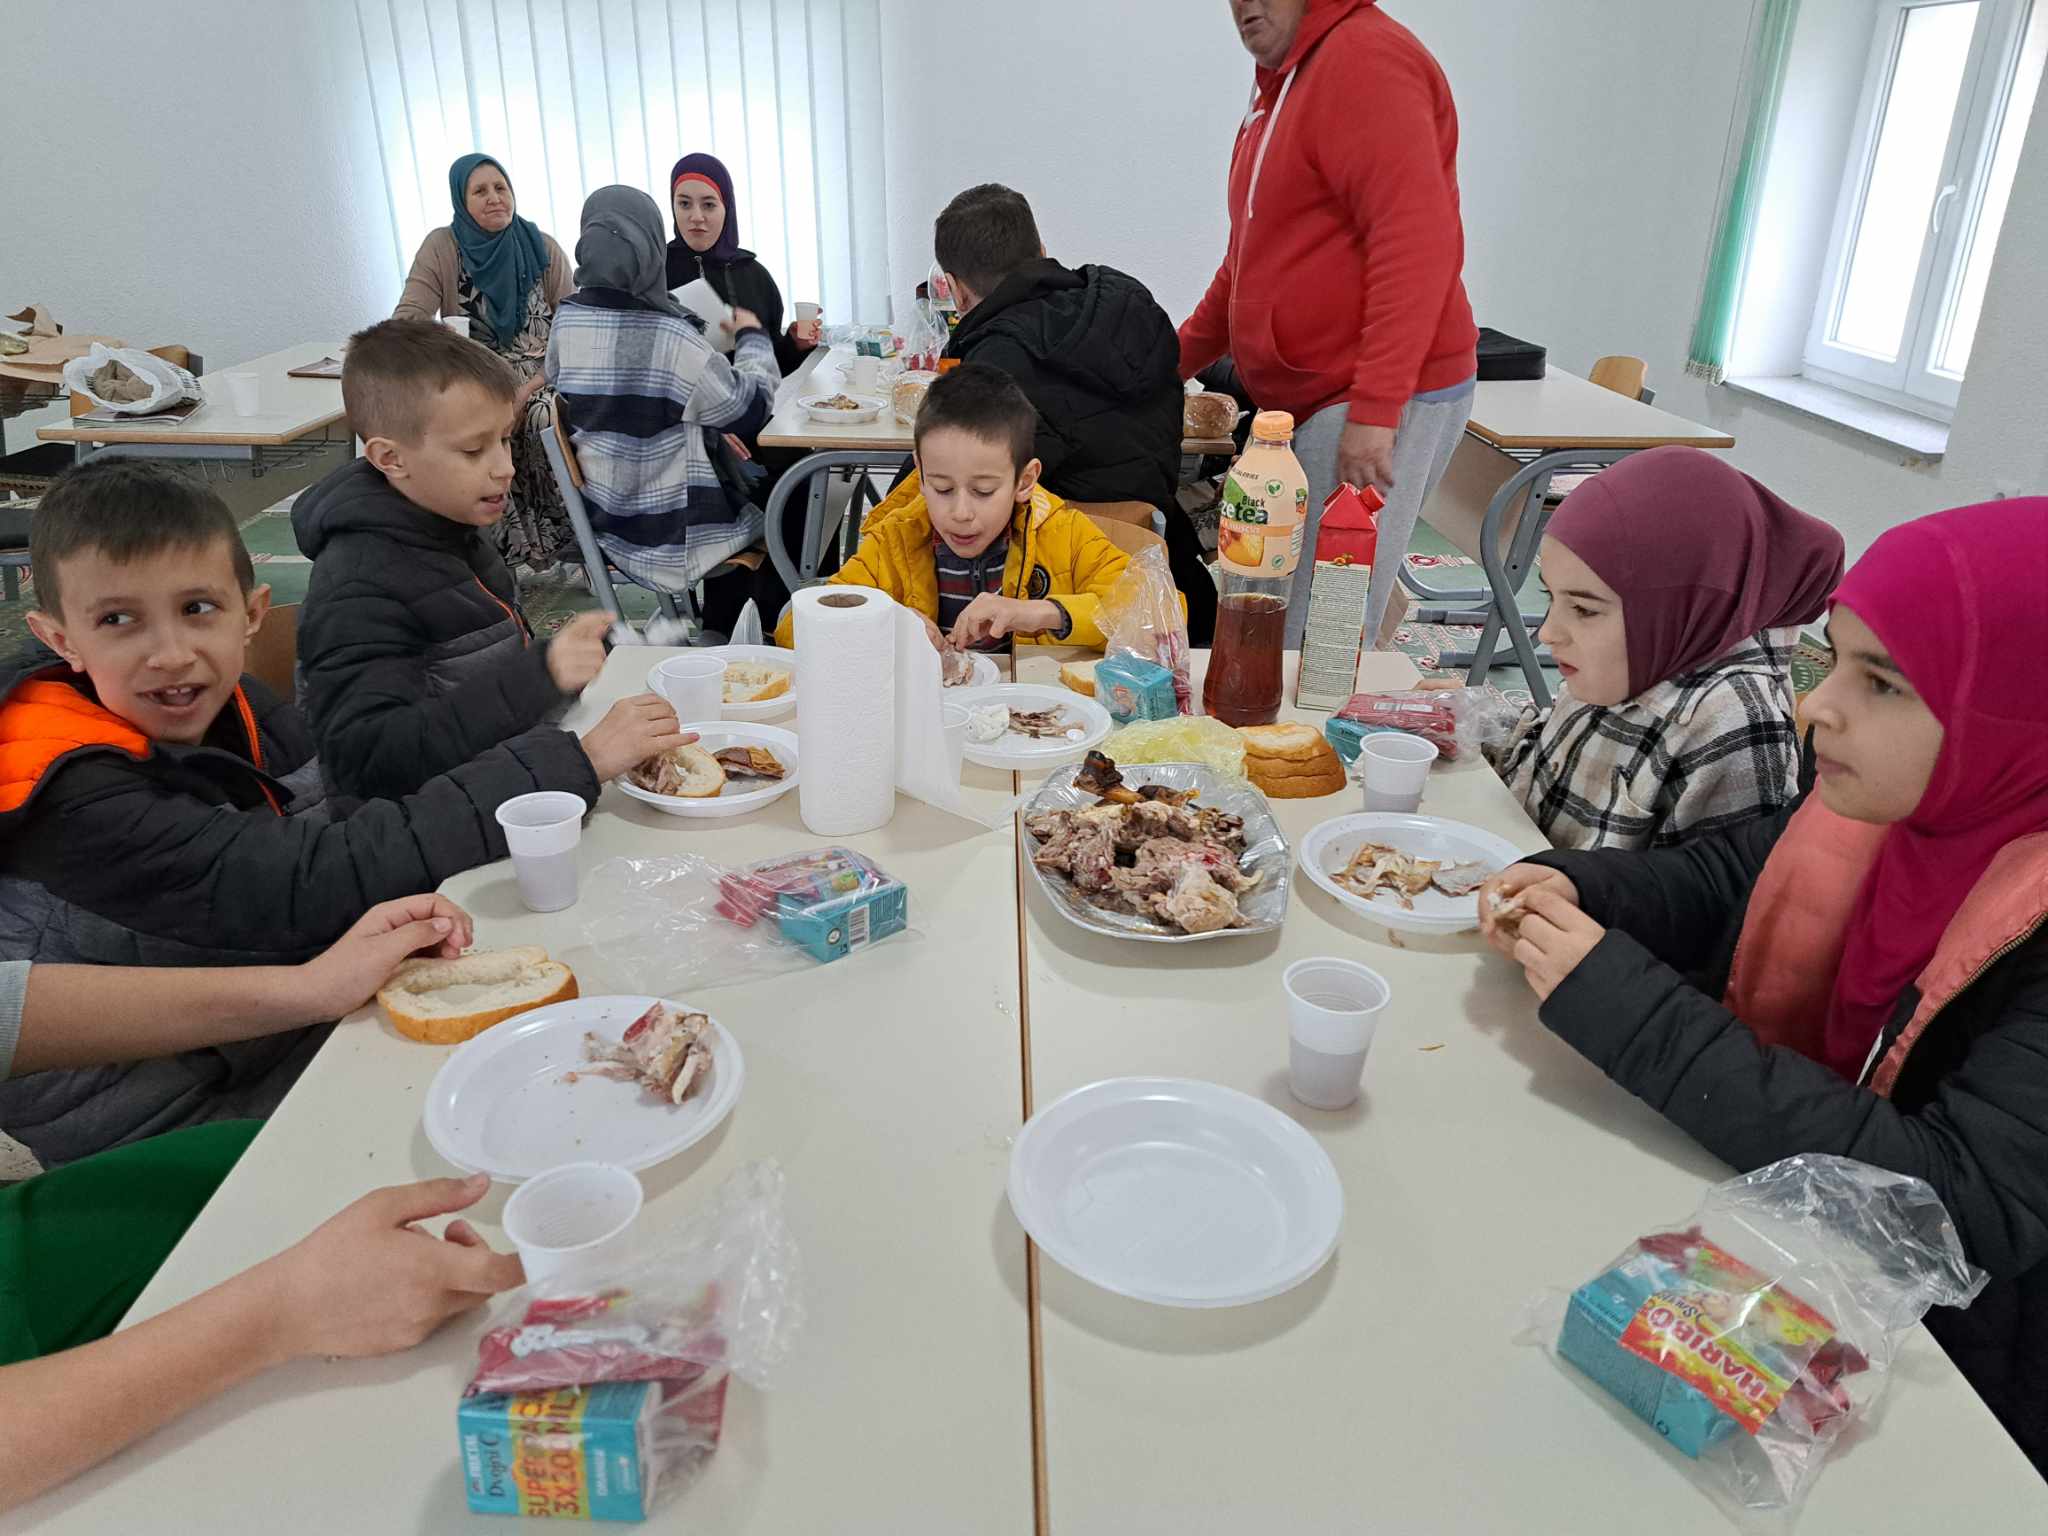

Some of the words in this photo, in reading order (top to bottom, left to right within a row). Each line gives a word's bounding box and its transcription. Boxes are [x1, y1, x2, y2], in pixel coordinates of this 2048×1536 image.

[1242, 495, 1265, 507] Black
[1649, 1307, 1767, 1399] HARIBO
[523, 1454, 551, 1517] SUPER
